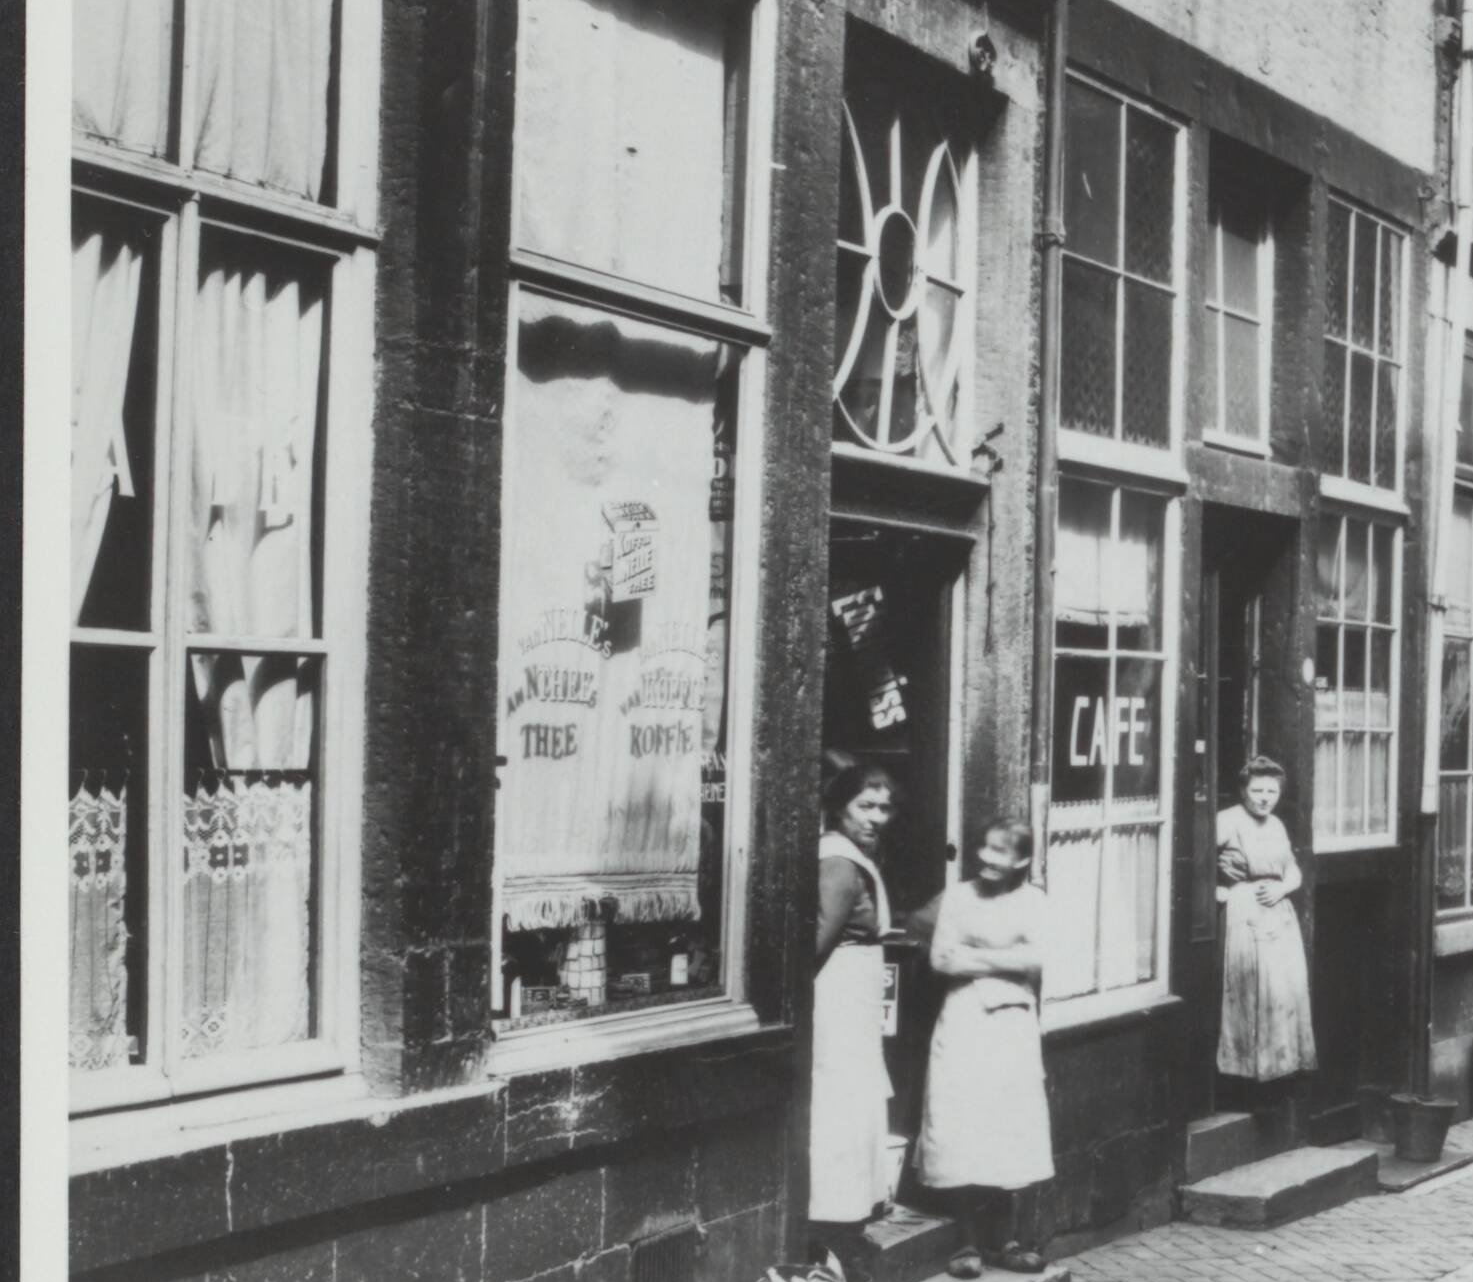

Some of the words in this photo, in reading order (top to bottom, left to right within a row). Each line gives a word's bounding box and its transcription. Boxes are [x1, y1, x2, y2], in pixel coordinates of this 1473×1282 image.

[520, 723, 578, 760] THEE
[630, 721, 694, 759] KOFFIE
[1070, 696, 1146, 765] CAFE
